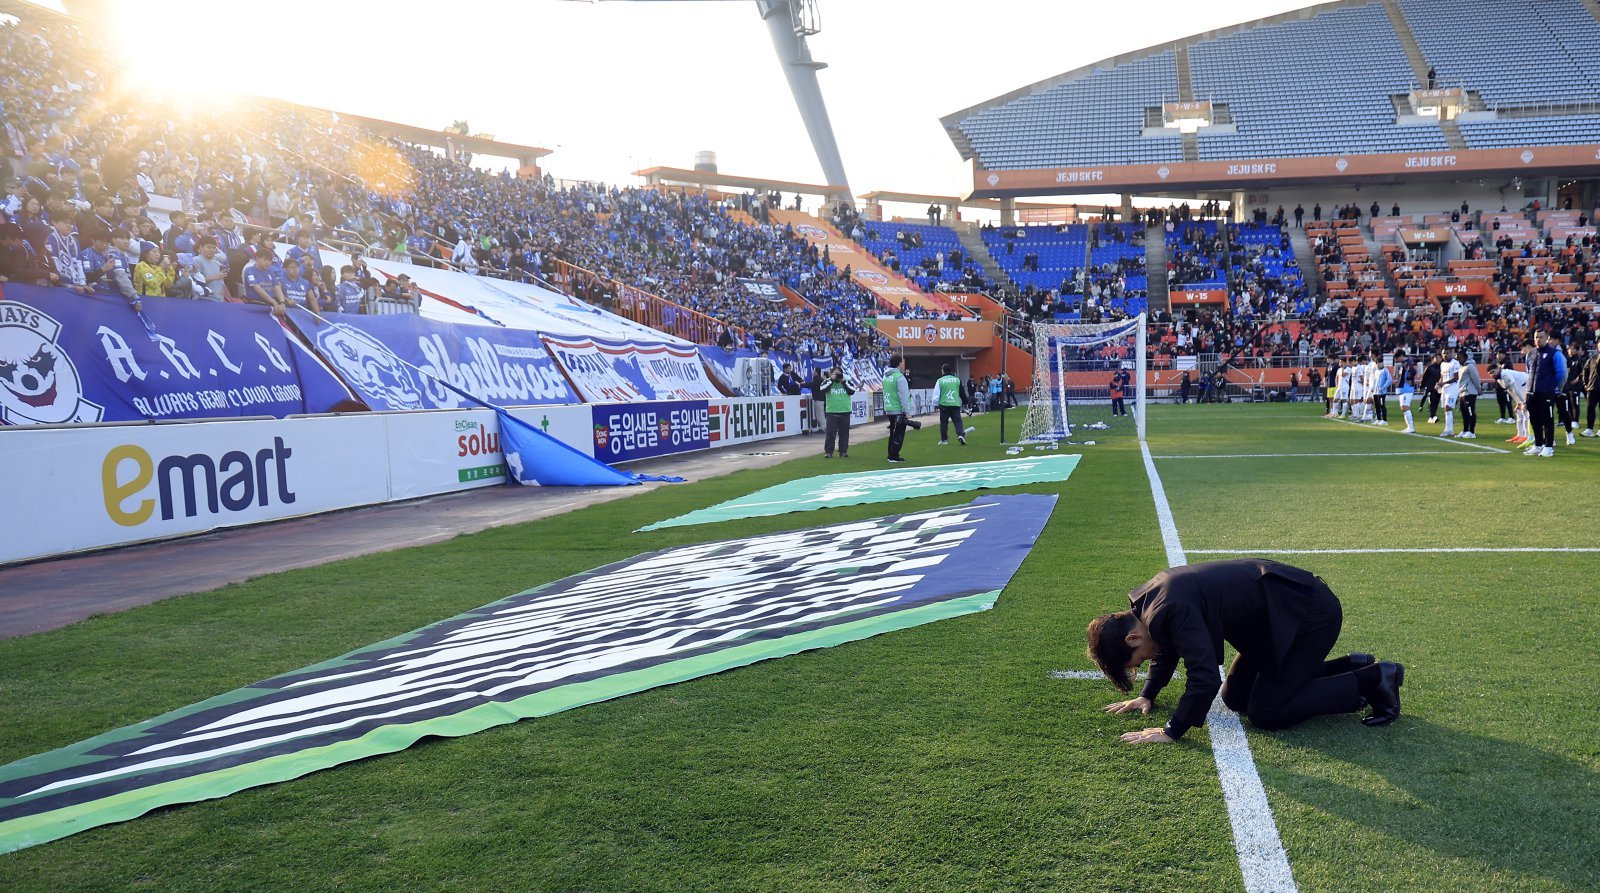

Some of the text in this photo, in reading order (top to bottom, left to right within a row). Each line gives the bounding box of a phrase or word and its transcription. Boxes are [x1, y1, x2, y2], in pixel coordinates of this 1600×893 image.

[1405, 155, 1456, 167] JEJU SK FC
[1227, 163, 1276, 175] JEJU SK FC
[1056, 170, 1103, 182] JEJU SK FC
[950, 295, 968, 303] W-17
[1186, 292, 1208, 300] W-15
[0, 306, 40, 328] AYS
[896, 326, 921, 339] JEJU
[940, 327, 952, 339] SK
[953, 327, 965, 339] FC
[609, 412, 659, 454] 동원샘물
[670, 409, 709, 445] 동원샘물
[458, 423, 502, 457] solu
[101, 436, 296, 527] emart
